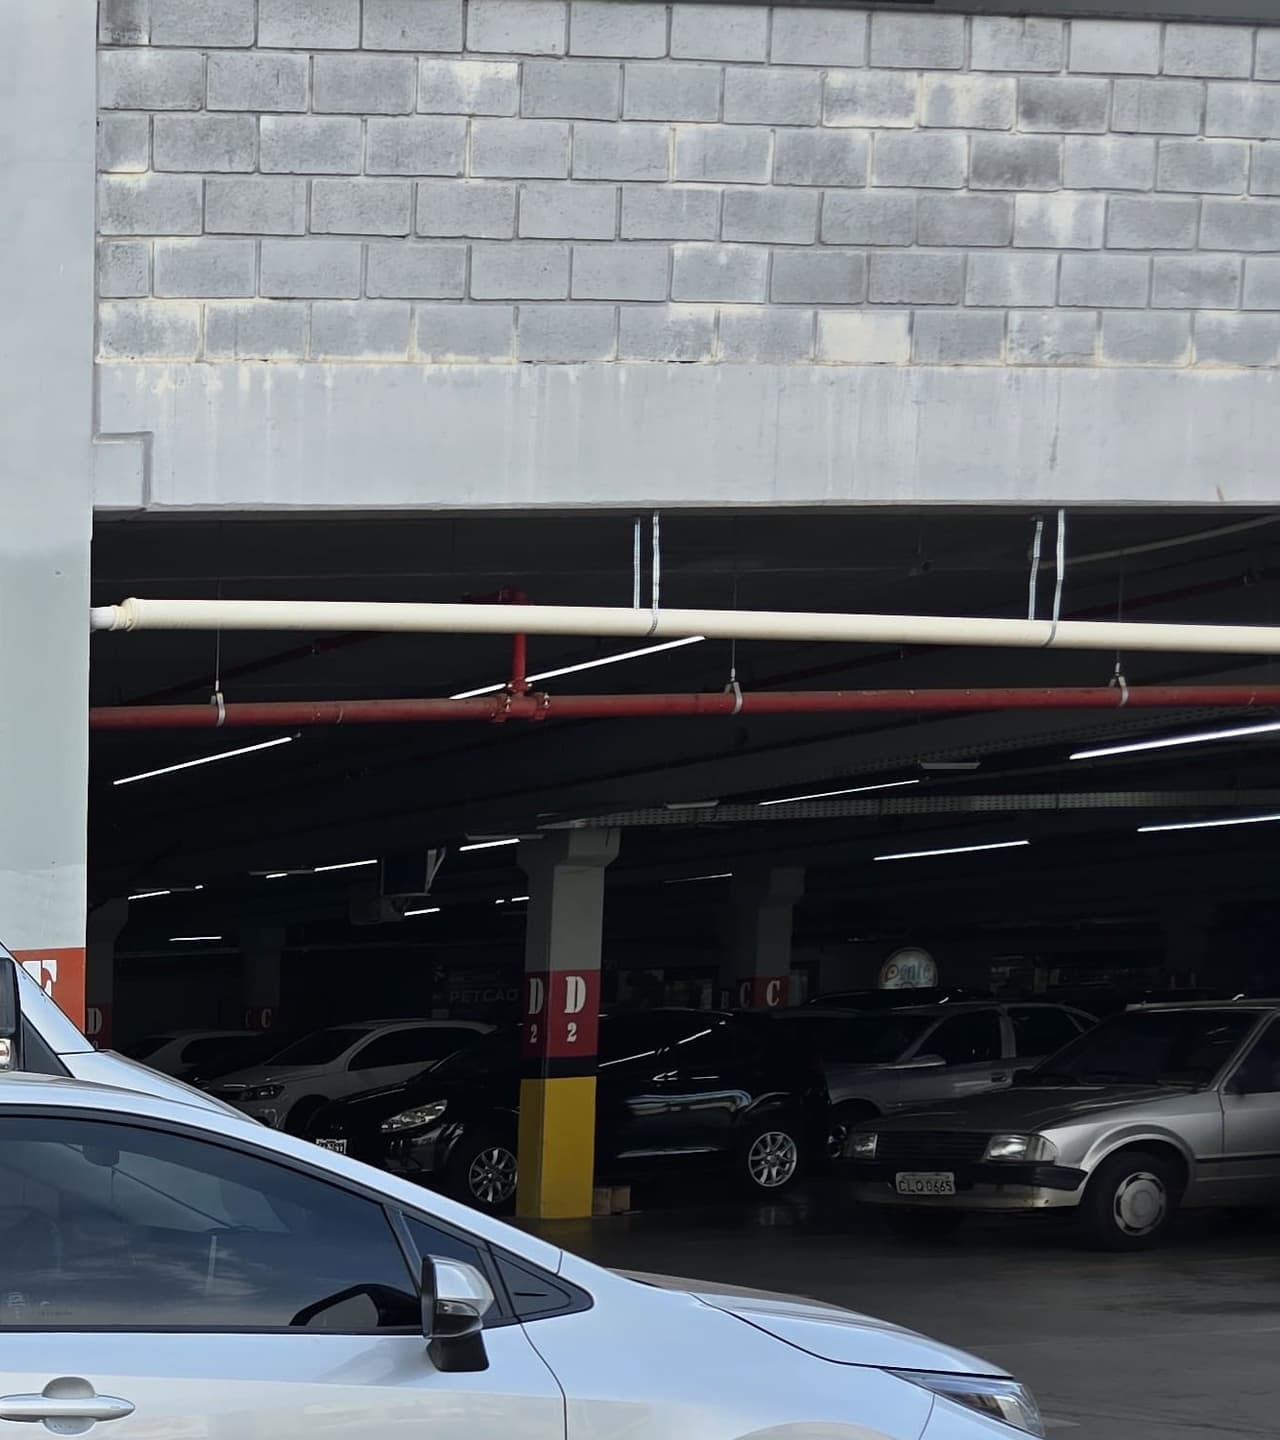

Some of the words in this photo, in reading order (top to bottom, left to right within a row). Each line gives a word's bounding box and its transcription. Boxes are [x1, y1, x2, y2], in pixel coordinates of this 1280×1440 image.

[528, 977, 544, 1014] D
[564, 976, 586, 1014] D
[766, 980, 781, 1007] C
[87, 1008, 103, 1034] D
[261, 1008, 272, 1028] C
[529, 1023, 539, 1043] 2
[566, 1022, 578, 1042] 2
